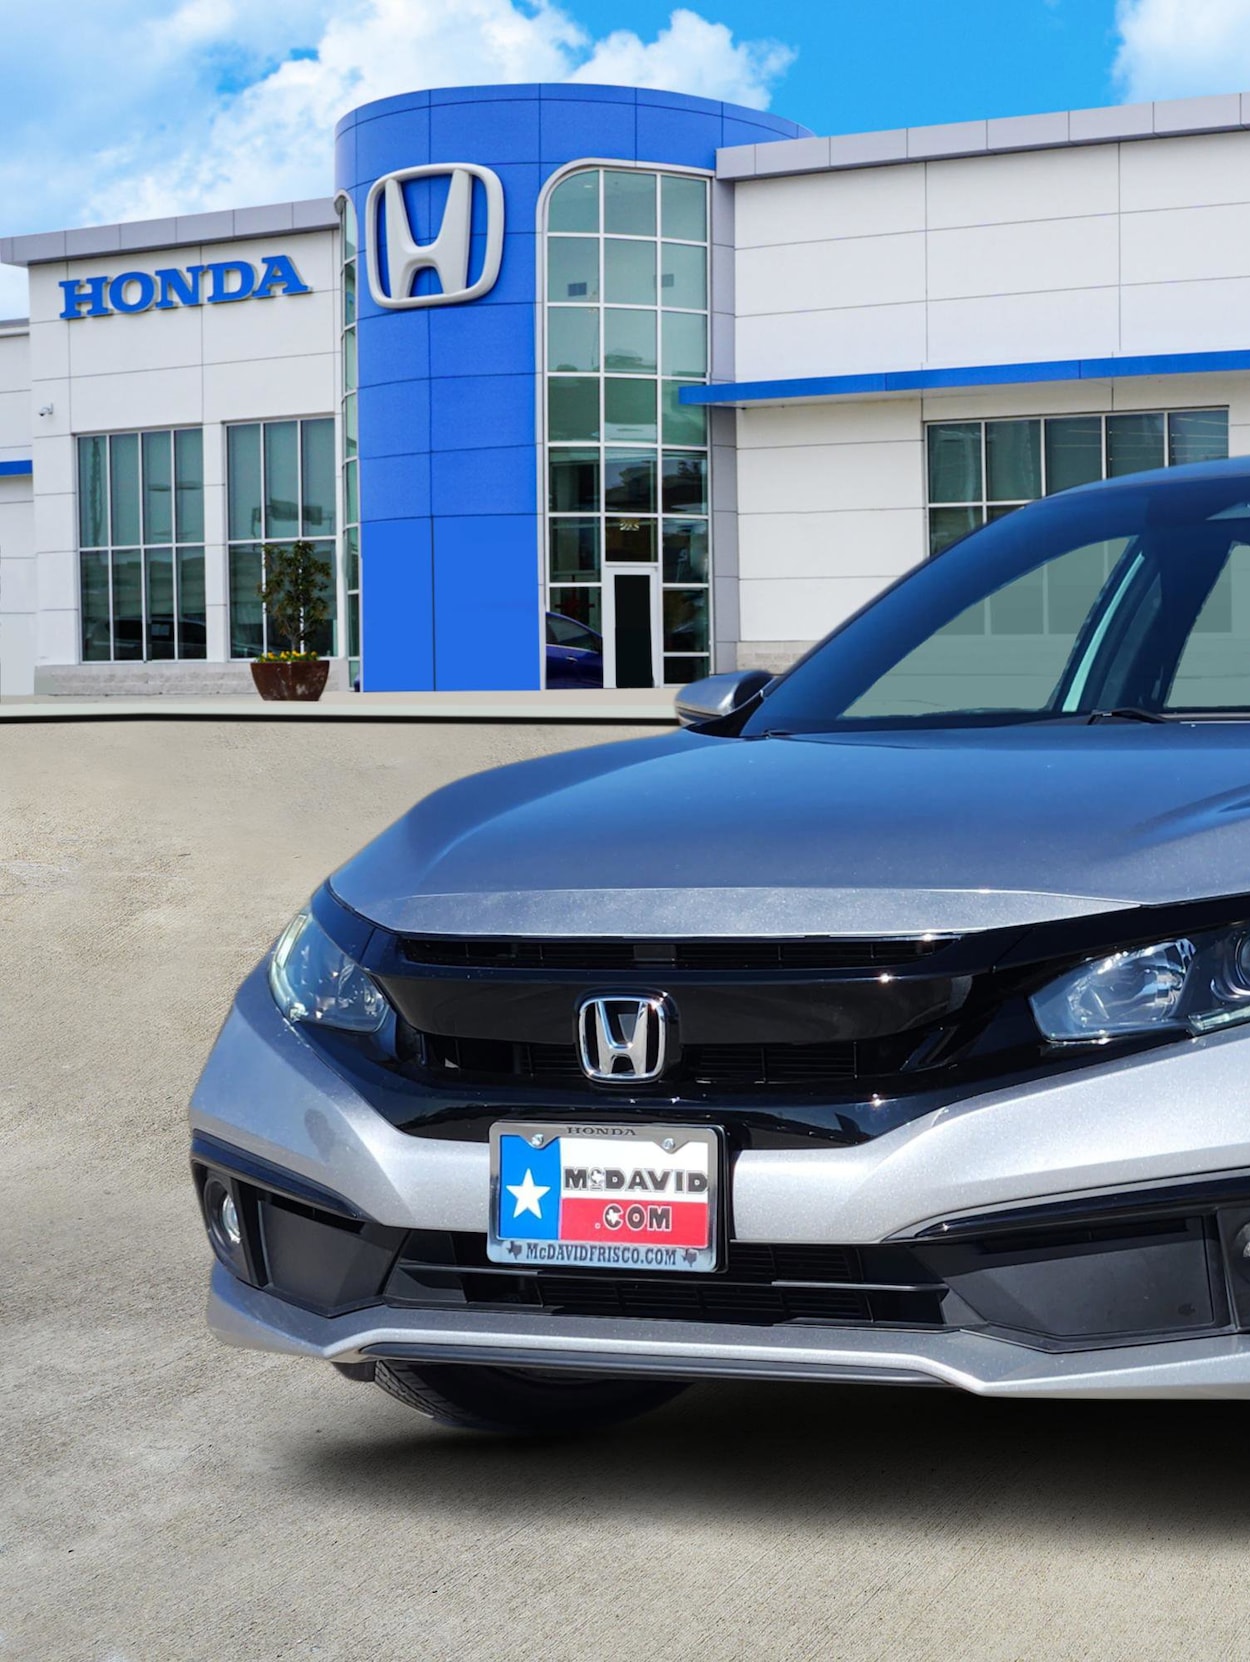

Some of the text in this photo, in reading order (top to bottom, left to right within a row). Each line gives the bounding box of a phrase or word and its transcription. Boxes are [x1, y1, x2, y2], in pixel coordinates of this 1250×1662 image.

[58, 254, 311, 320] HONDA
[565, 1126, 637, 1137] HONDA
[594, 1203, 673, 1232] .COM
[525, 1242, 677, 1267] McDAVIDFRISCO.COM
